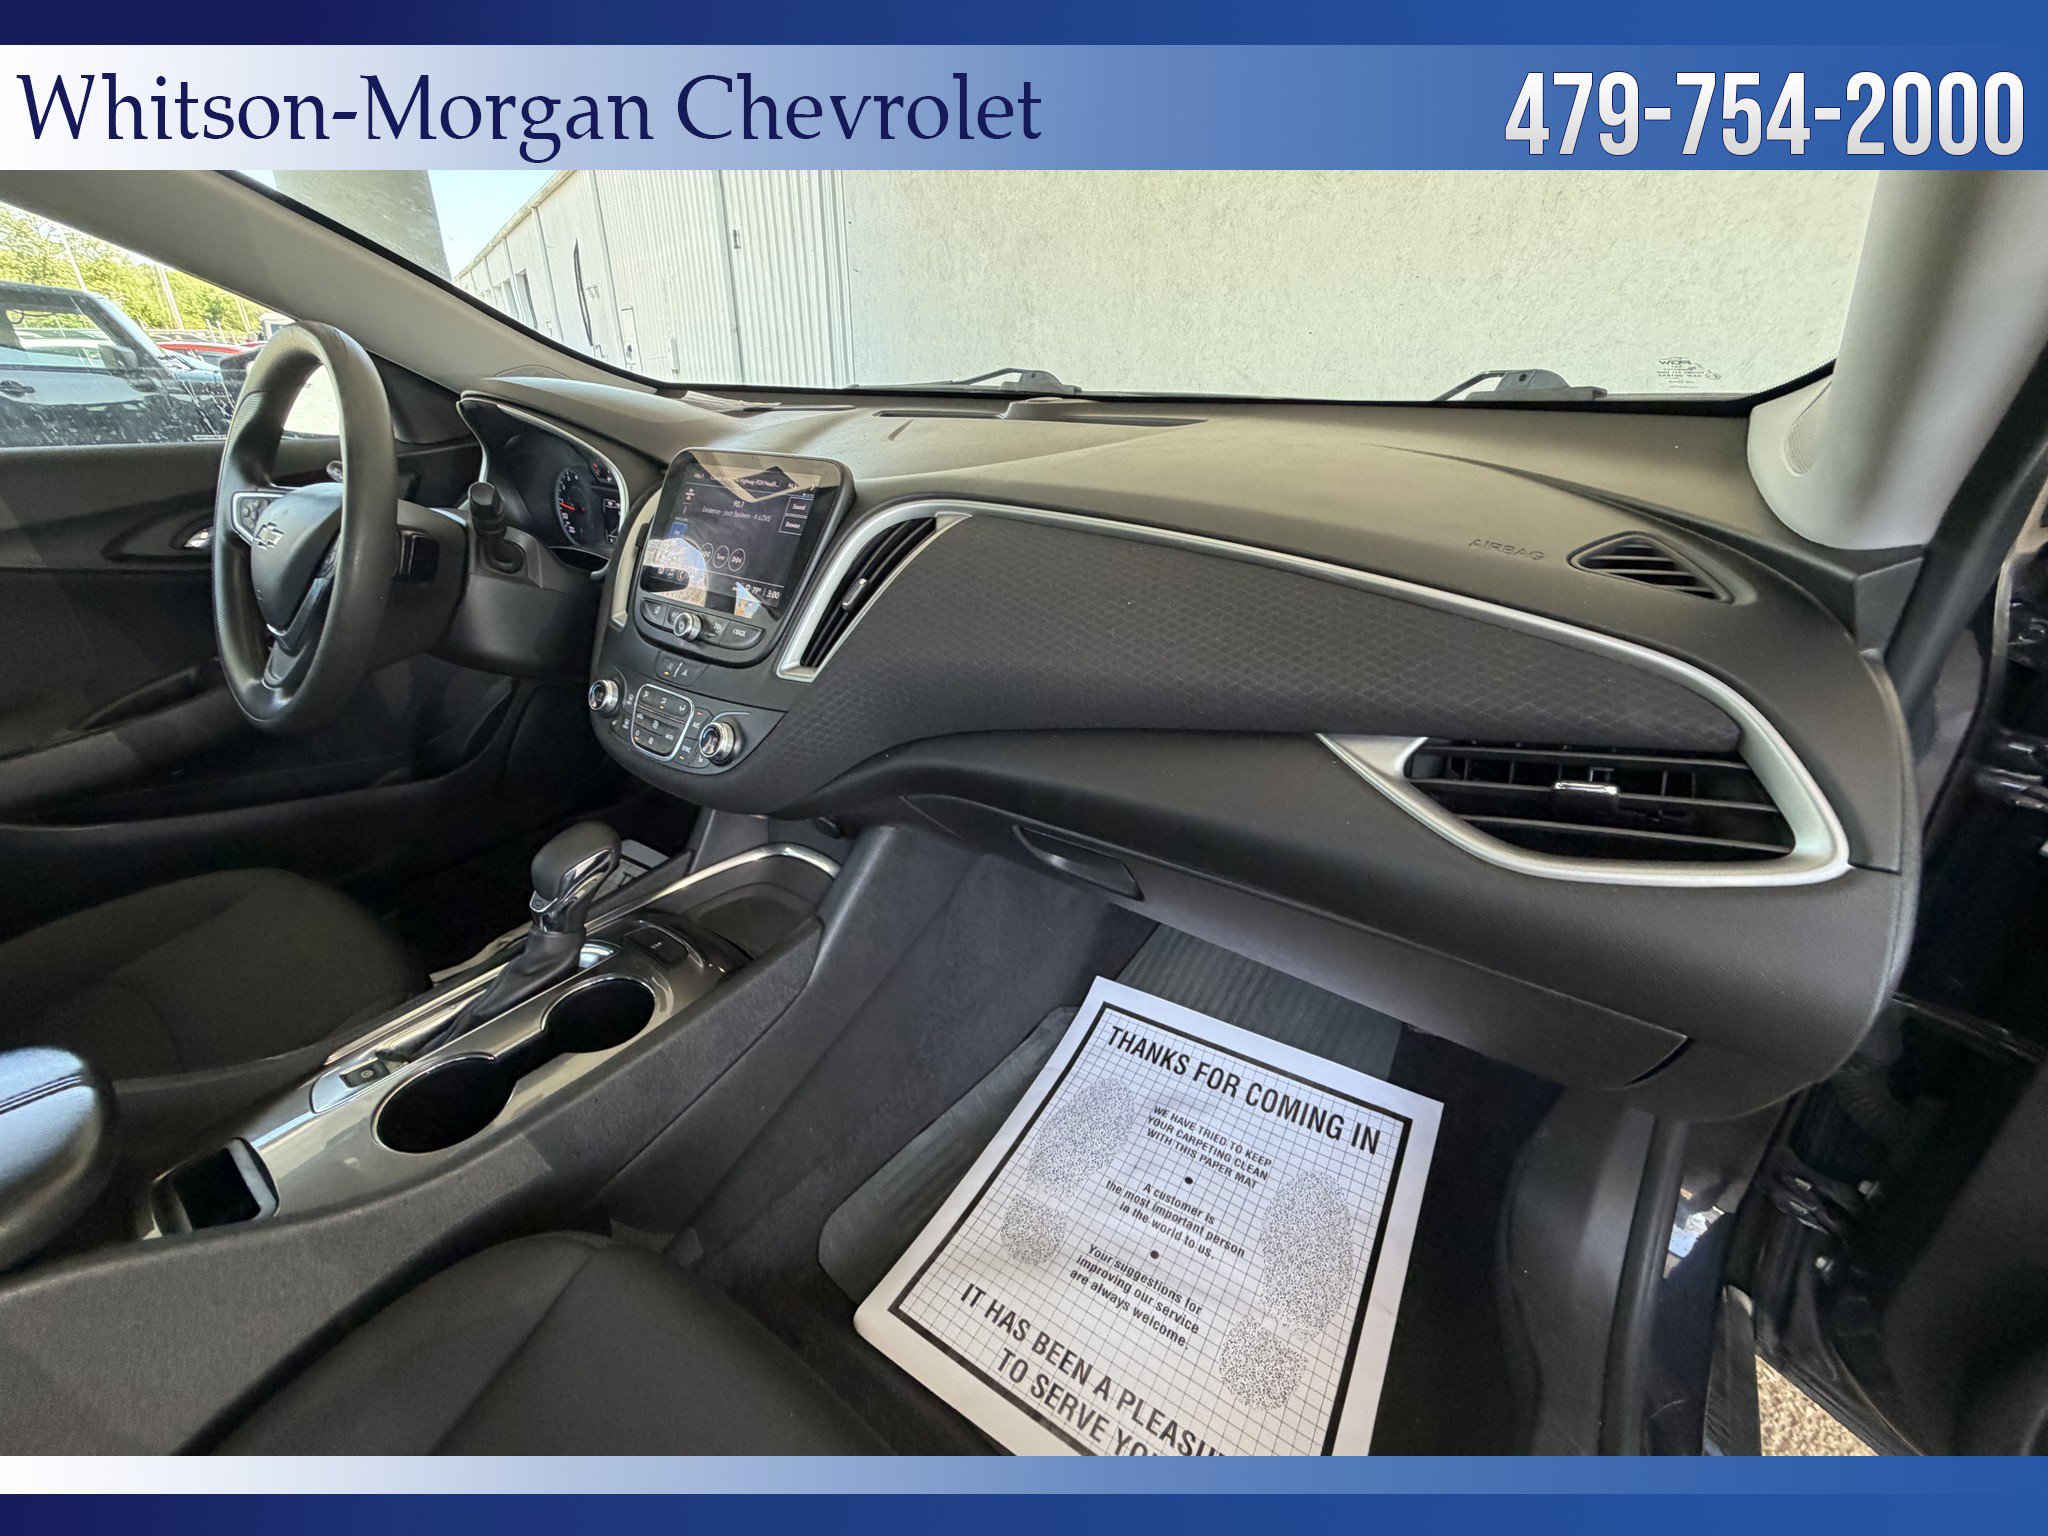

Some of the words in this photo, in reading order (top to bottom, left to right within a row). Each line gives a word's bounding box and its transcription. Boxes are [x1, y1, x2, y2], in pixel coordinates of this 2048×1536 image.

[733, 500, 745, 508] 90.7
[754, 514, 772, 523] K-LOVE
[792, 503, 807, 511] Sound
[1468, 538, 1546, 561] AIRBAG
[766, 589, 780, 599] 3:00
[732, 628, 746, 637] BACK
[1107, 1025, 1190, 1075] THANKS
[1193, 1061, 1241, 1098] FOR
[1245, 1082, 1345, 1141] COMING
[1351, 1122, 1381, 1155] IN
[1147, 1128, 1172, 1146] WITH
[1174, 1141, 1198, 1159] THIS
[1199, 1153, 1233, 1177] PAPER
[1234, 1171, 1259, 1189] MAT
[1148, 1115, 1174, 1135] YOUR
[1176, 1129, 1232, 1162] CARPETING
[1234, 1157, 1268, 1181] CLEAN
[1154, 1106, 1169, 1117] WE
[1171, 1112, 1196, 1131] HAVE
[1199, 1126, 1227, 1146] TRIED
[1230, 1140, 1243, 1154] TO
[1245, 1150, 1272, 1167] KEEP
[1106, 1180, 1122, 1194] the
[1124, 1191, 1150, 1209] most
[1151, 1203, 1205, 1236] important
[1206, 1232, 1245, 1258] person
[1119, 1202, 1131, 1214] in
[1132, 1209, 1149, 1224] the
[1151, 1220, 1183, 1241] world
[1184, 1235, 1195, 1249] to
[1198, 1244, 1214, 1260] us.
[1143, 1183, 1151, 1193] A
[1153, 1189, 1202, 1218] customer
[1204, 1212, 1216, 1225] is
[1076, 1255, 1133, 1294] improving
[1134, 1289, 1154, 1305] our
[1155, 1302, 1199, 1335] service
[1089, 1243, 1112, 1263] Your
[1114, 1260, 1183, 1304] suggestions
[1185, 1298, 1202, 1315] for
[1069, 1271, 1088, 1285] are
[1090, 1281, 1130, 1312] always
[1133, 1306, 1189, 1350] welcome.
[960, 1283, 987, 1309] IT
[984, 1300, 1032, 1343] HAS
[1031, 1331, 1094, 1386] BEEN
[1092, 1375, 1112, 1401] A
[996, 1347, 1029, 1384] TO
[1031, 1373, 1110, 1443] SERVE
[1114, 1428, 1162, 1456] YO
